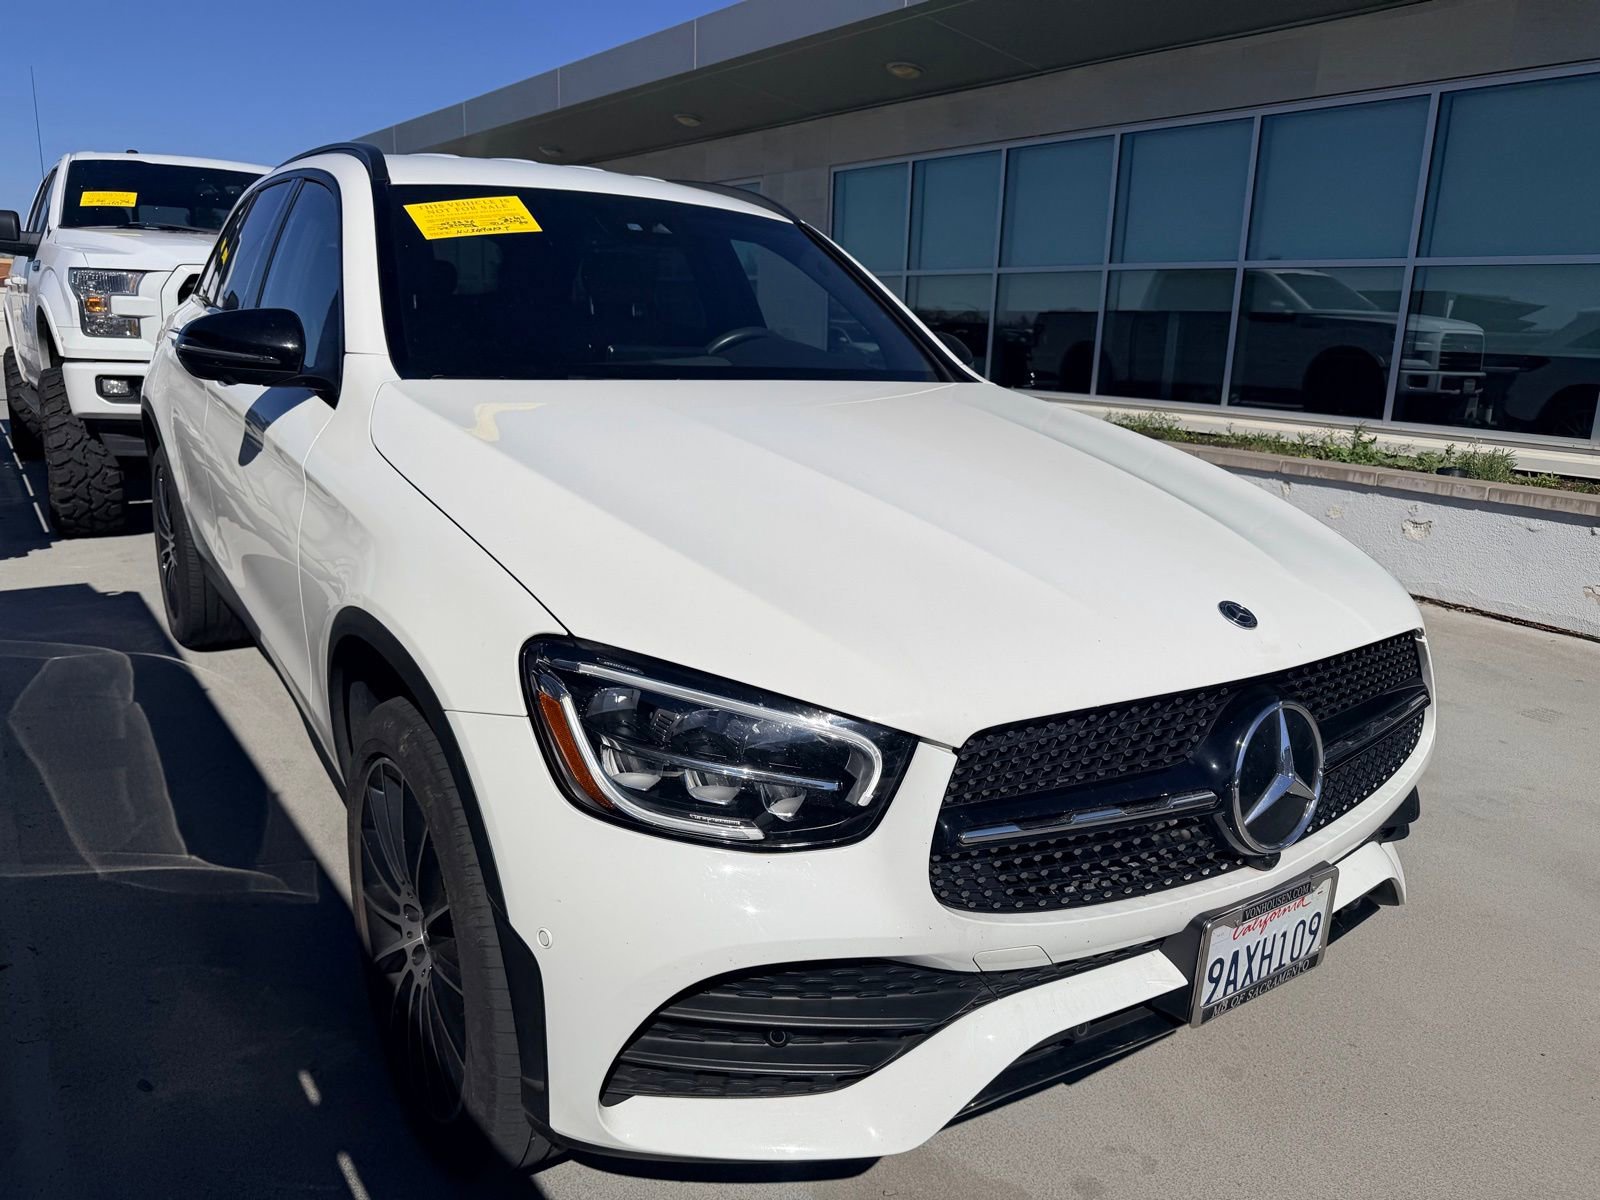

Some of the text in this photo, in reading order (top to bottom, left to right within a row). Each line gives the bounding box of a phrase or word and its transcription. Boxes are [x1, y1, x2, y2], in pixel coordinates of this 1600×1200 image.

[419, 202, 445, 210] THIS
[447, 199, 495, 207] VEHICLE
[1232, 895, 1312, 941] California
[1245, 883, 1310, 919] VONHOUSEN.COM
[1204, 911, 1322, 1005] 9AXH109
[1212, 959, 1310, 1017] MB OF SACRAMENTO
